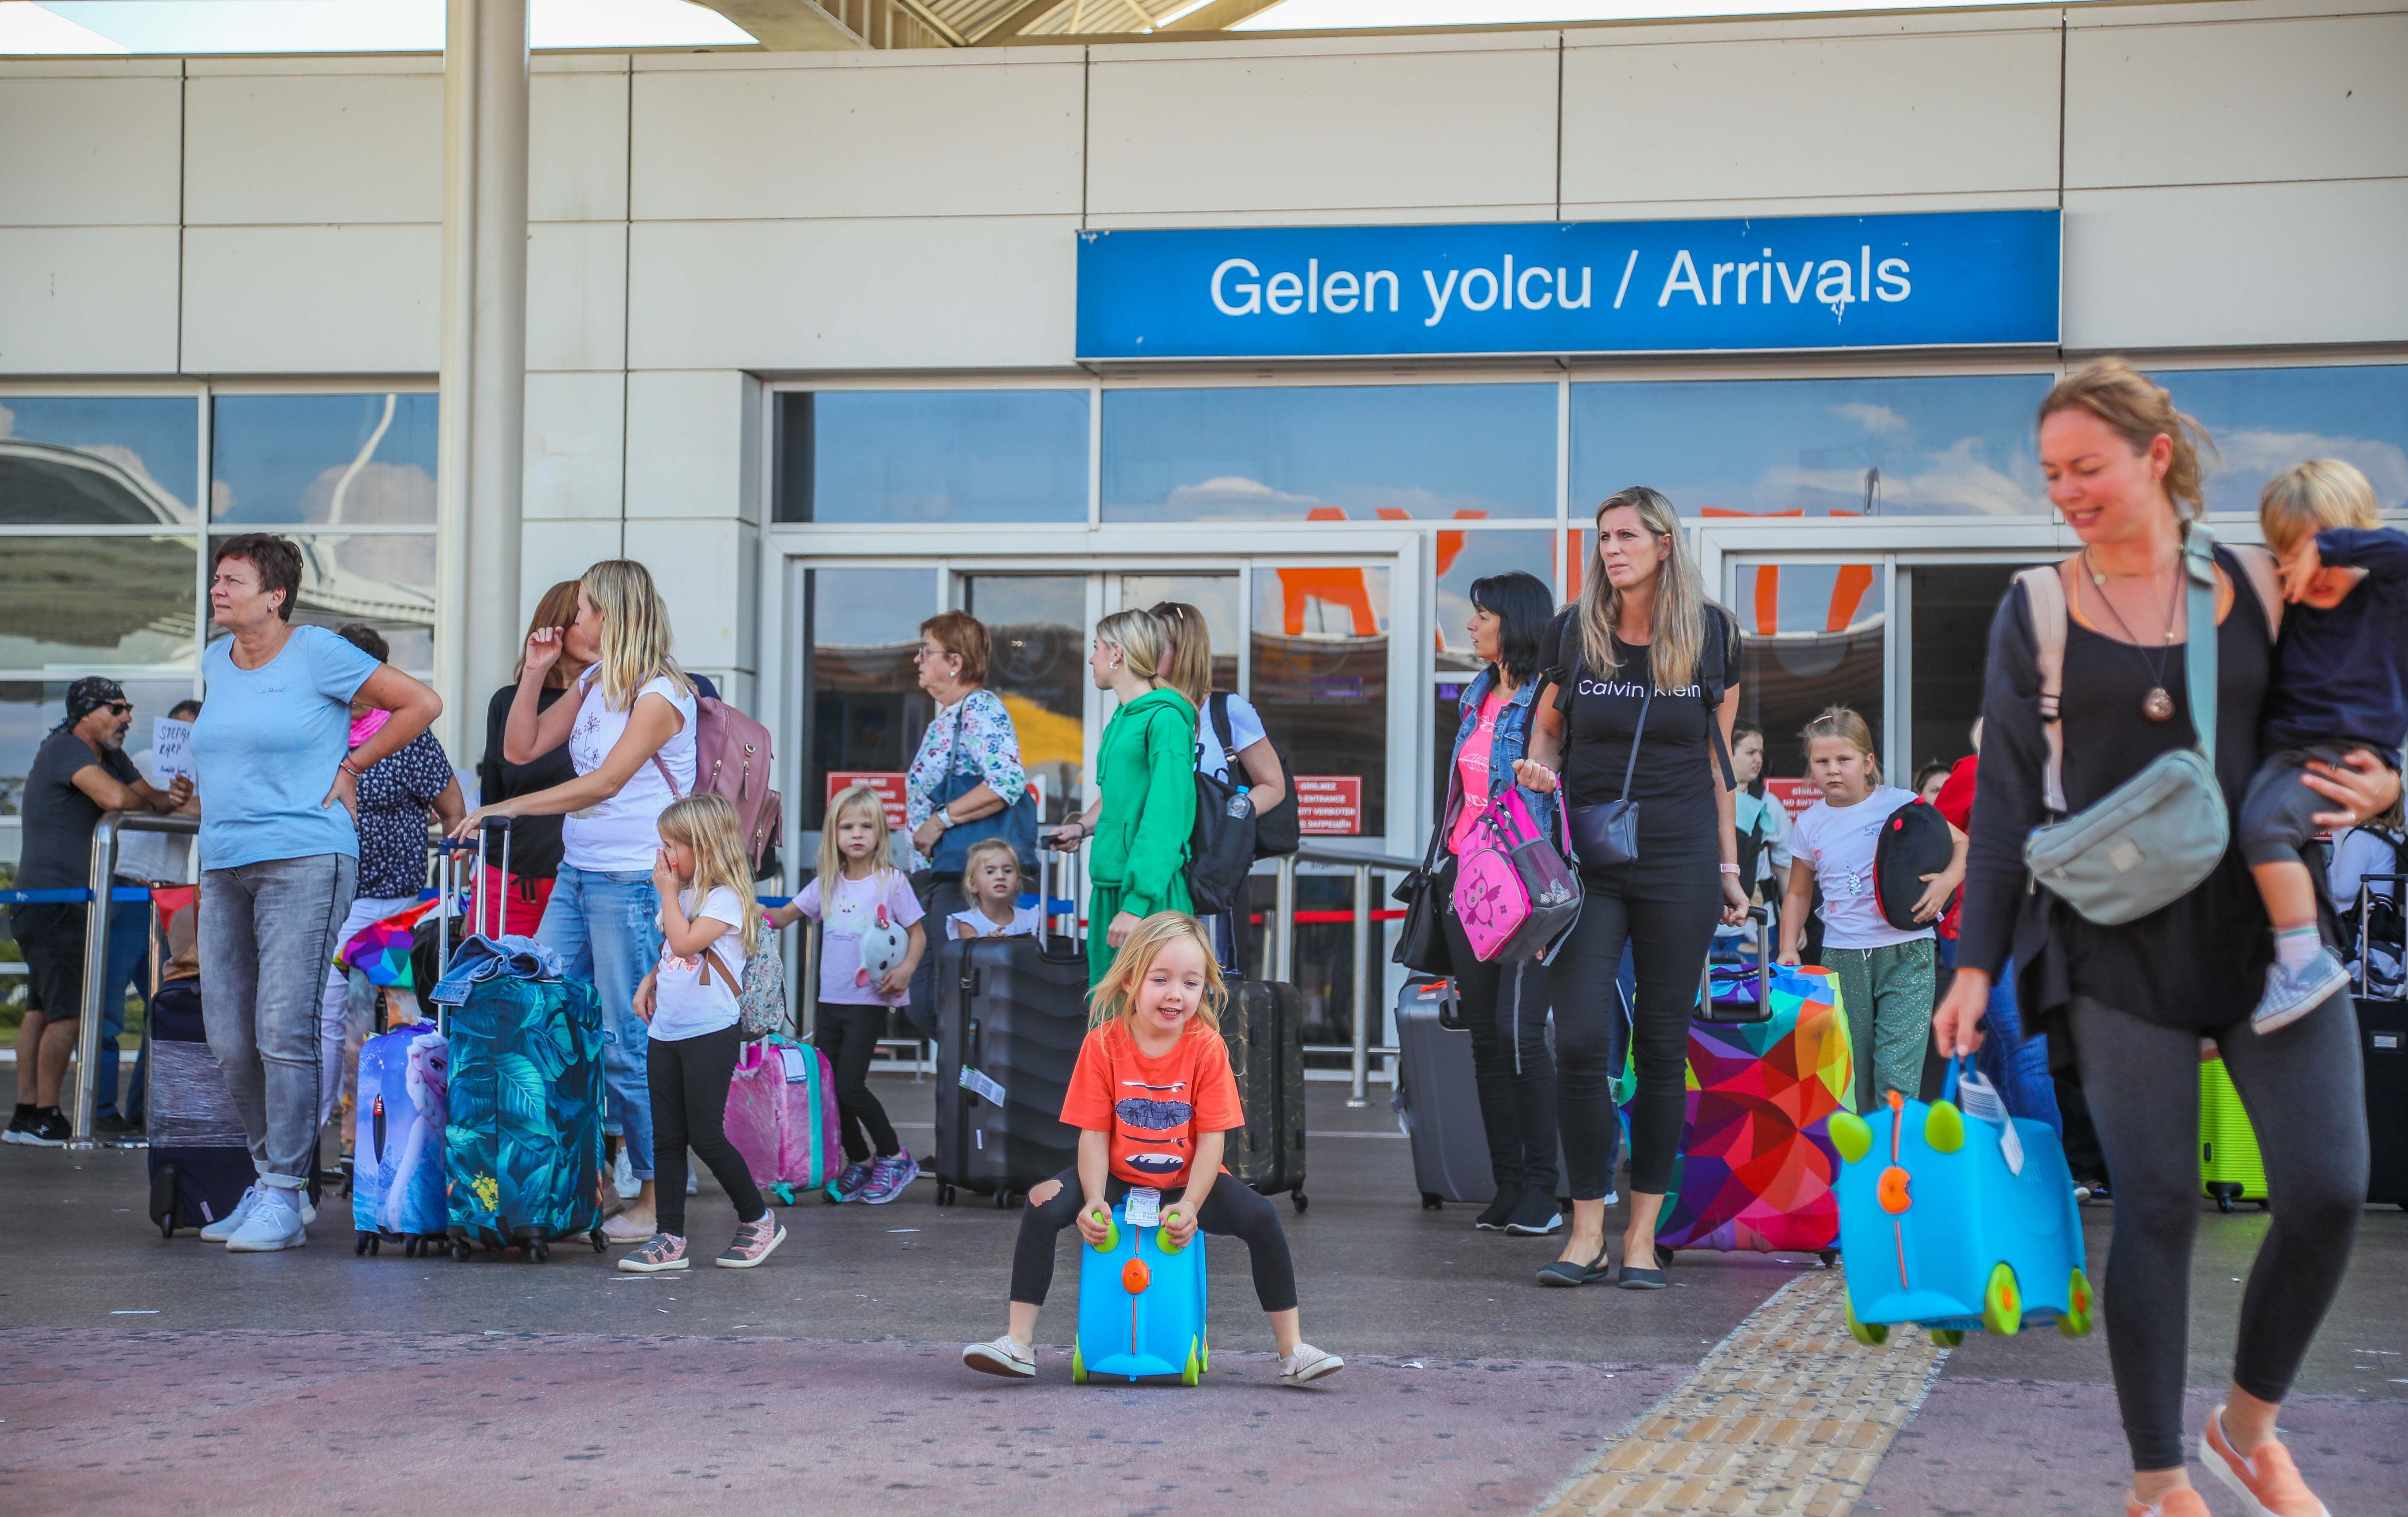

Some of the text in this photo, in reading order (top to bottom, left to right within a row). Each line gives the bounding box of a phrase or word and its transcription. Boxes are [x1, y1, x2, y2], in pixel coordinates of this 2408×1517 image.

[1211, 245, 1911, 326] Gelen yolcu / Arrivals
[1579, 679, 1644, 698] Calvin
[1304, 795, 1346, 804] ENTRANCE
[1783, 799, 1795, 807] NO
[1314, 807, 1356, 816] VERBOTEN
